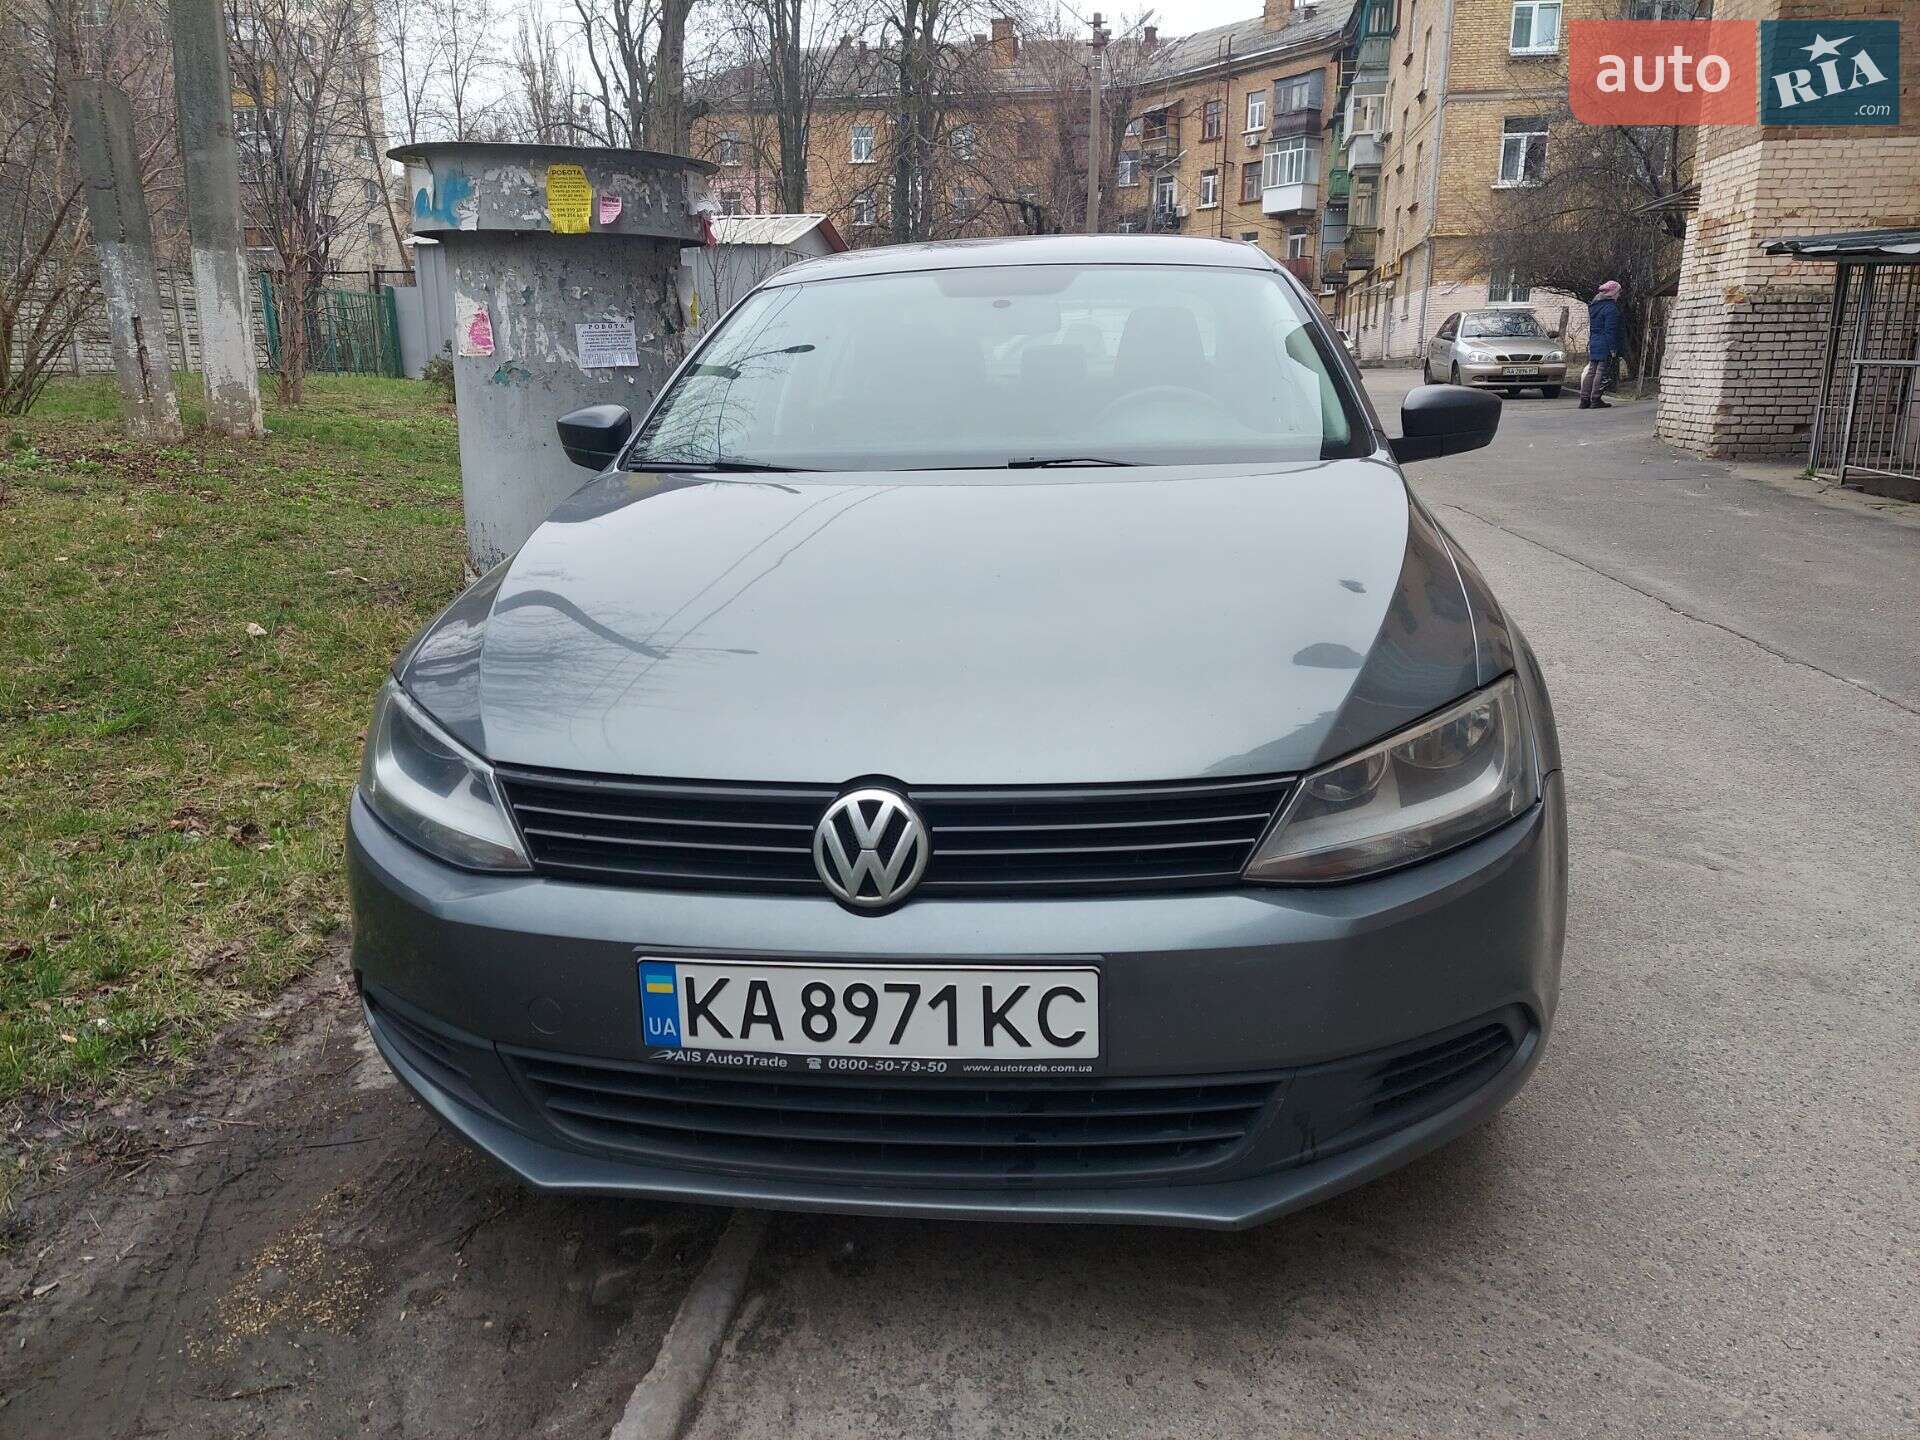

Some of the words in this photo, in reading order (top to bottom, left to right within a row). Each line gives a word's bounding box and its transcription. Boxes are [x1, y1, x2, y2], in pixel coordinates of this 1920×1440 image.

[685, 976, 785, 1041] KA
[800, 981, 958, 1048] 8971
[982, 984, 1087, 1049] KC
[649, 1017, 678, 1037] UA
[674, 1051, 702, 1062] AIS
[705, 1052, 788, 1067] AutoTrade
[827, 1058, 948, 1074] 0800-50-79-50
[962, 1063, 1094, 1074] www.autotrade.com.ua
